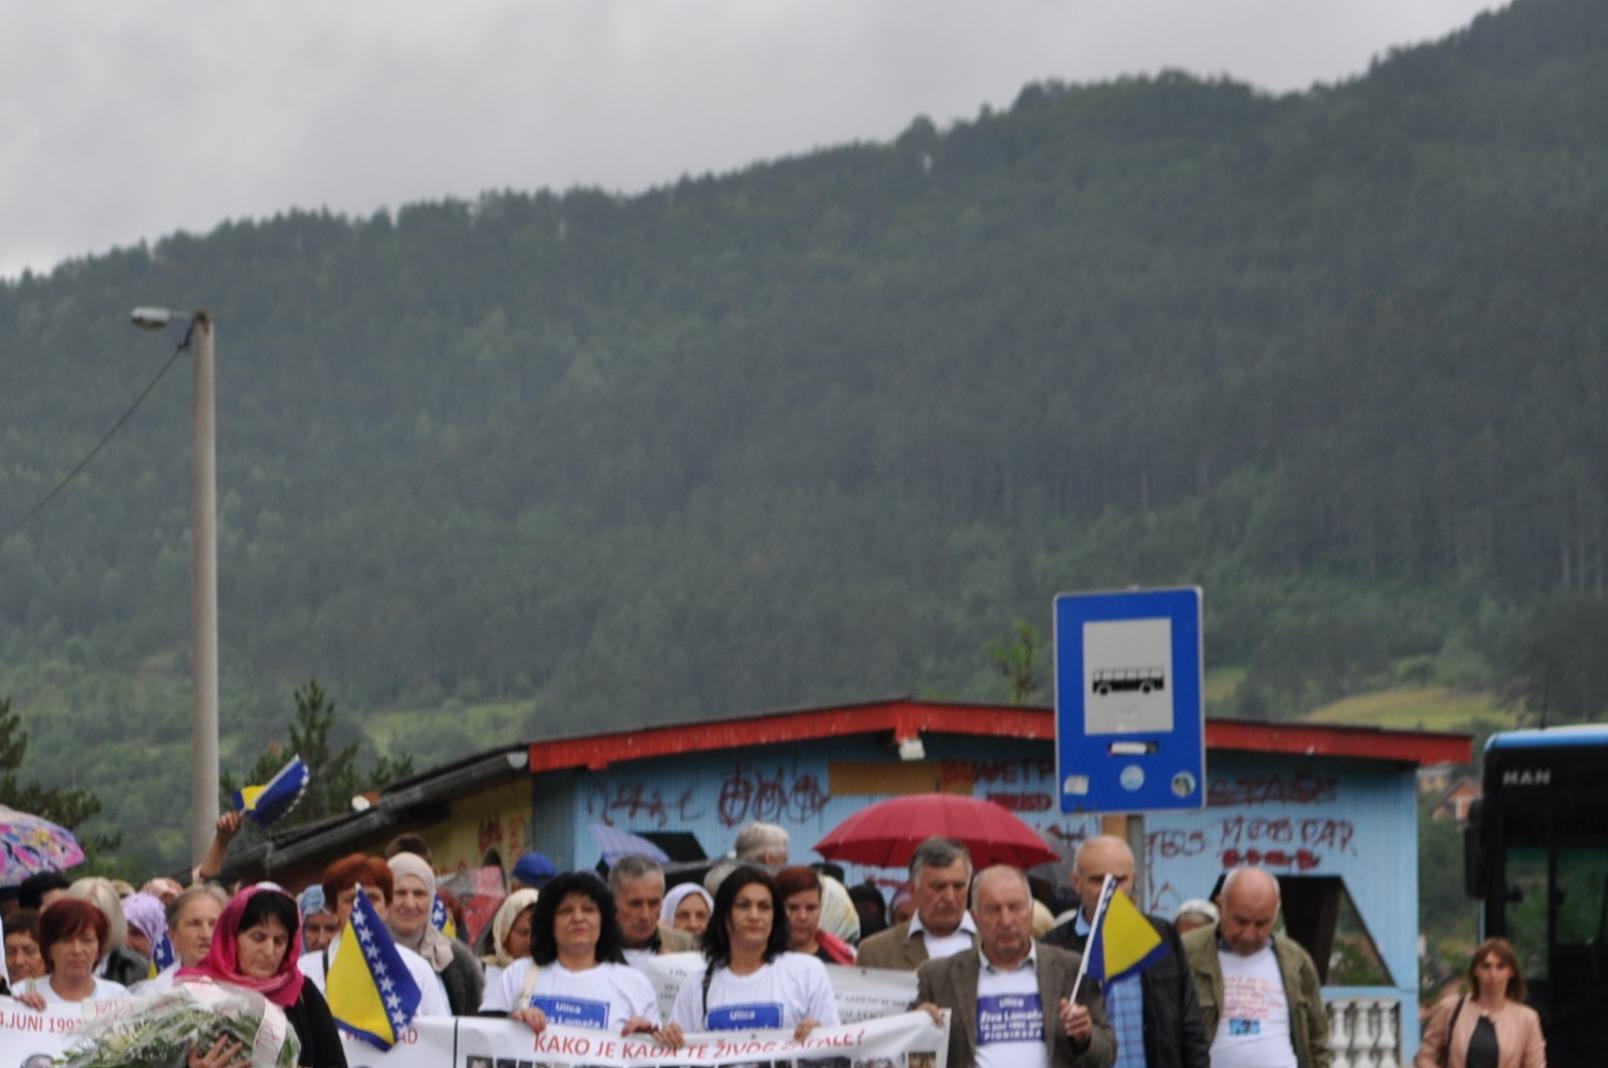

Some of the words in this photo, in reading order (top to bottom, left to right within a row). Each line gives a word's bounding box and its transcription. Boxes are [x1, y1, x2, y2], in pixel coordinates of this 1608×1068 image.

[1502, 769, 1551, 786] MAN
[555, 1002, 582, 1014] Ulica
[729, 1009, 756, 1021] Ulica
[534, 1034, 591, 1057] KAKO
[595, 1039, 616, 1059] JE
[622, 1042, 678, 1060] KADA
[687, 1043, 707, 1060] TE
